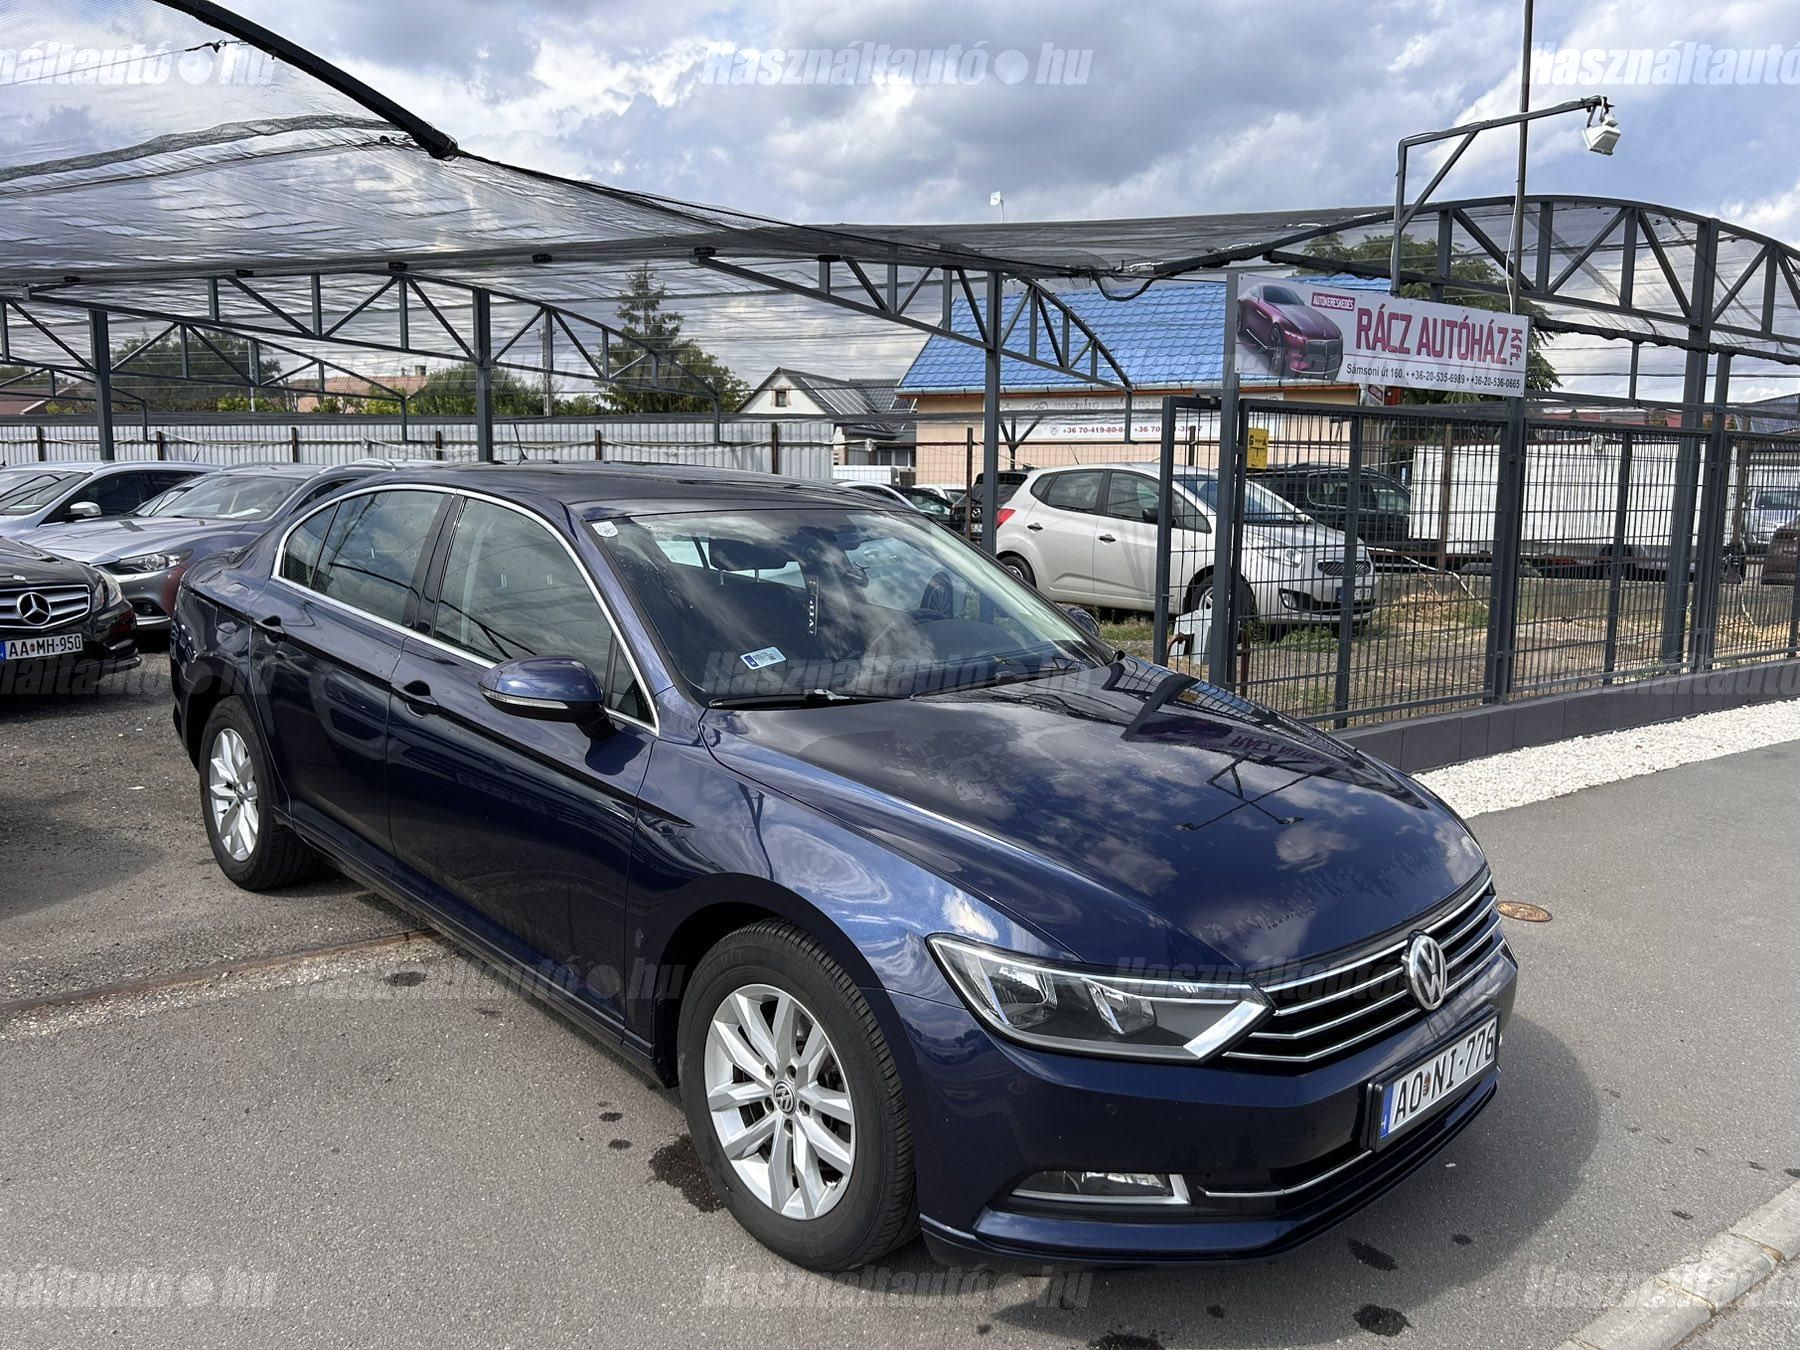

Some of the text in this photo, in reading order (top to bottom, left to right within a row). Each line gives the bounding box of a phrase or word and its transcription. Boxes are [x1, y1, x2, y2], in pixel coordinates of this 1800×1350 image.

[1356, 303, 1508, 365] RÁCZ AUTÓHÁZ
[1510, 328, 1523, 367] Kft.
